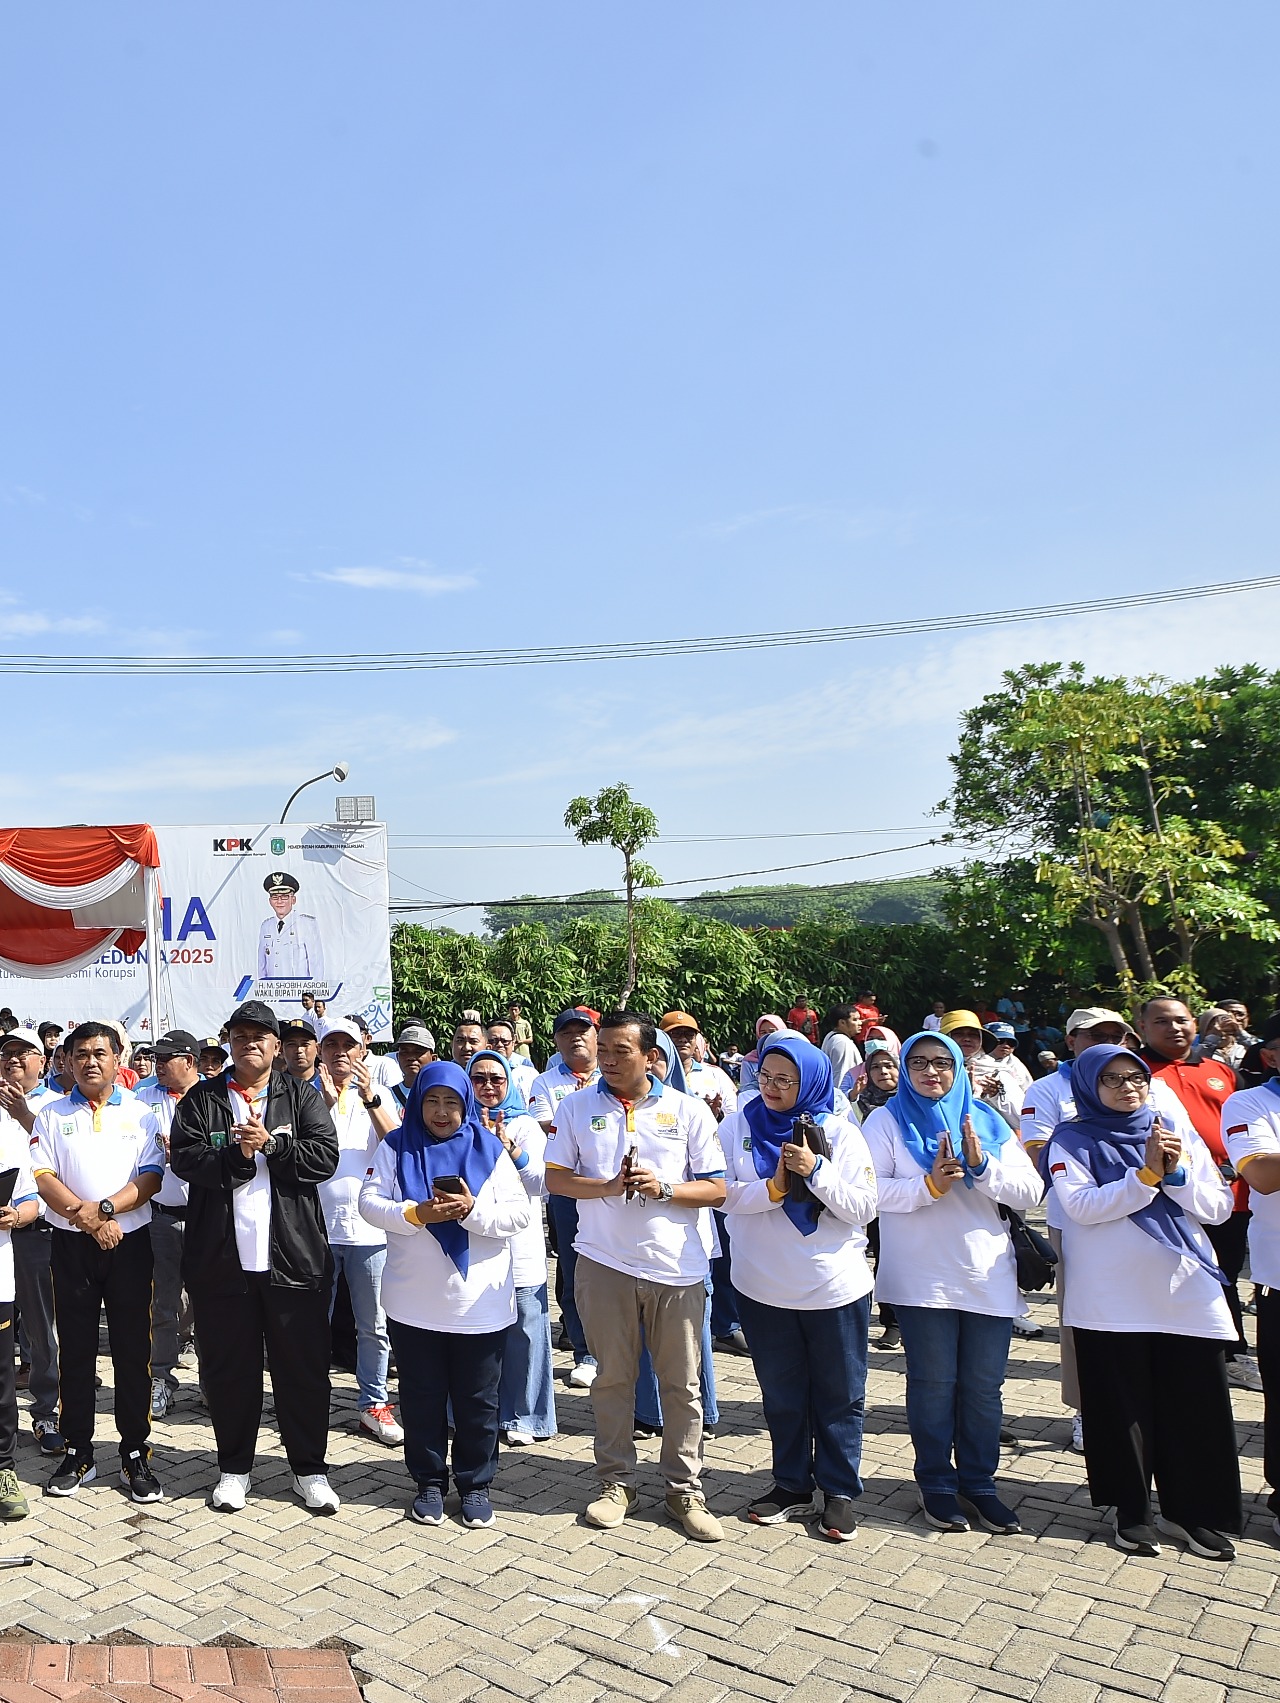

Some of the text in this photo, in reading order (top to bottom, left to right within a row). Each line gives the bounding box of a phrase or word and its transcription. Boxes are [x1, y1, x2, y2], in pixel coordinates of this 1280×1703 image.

[213, 838, 253, 851] KPK
[170, 948, 214, 964] 2025
[95, 966, 136, 980] Korupsi
